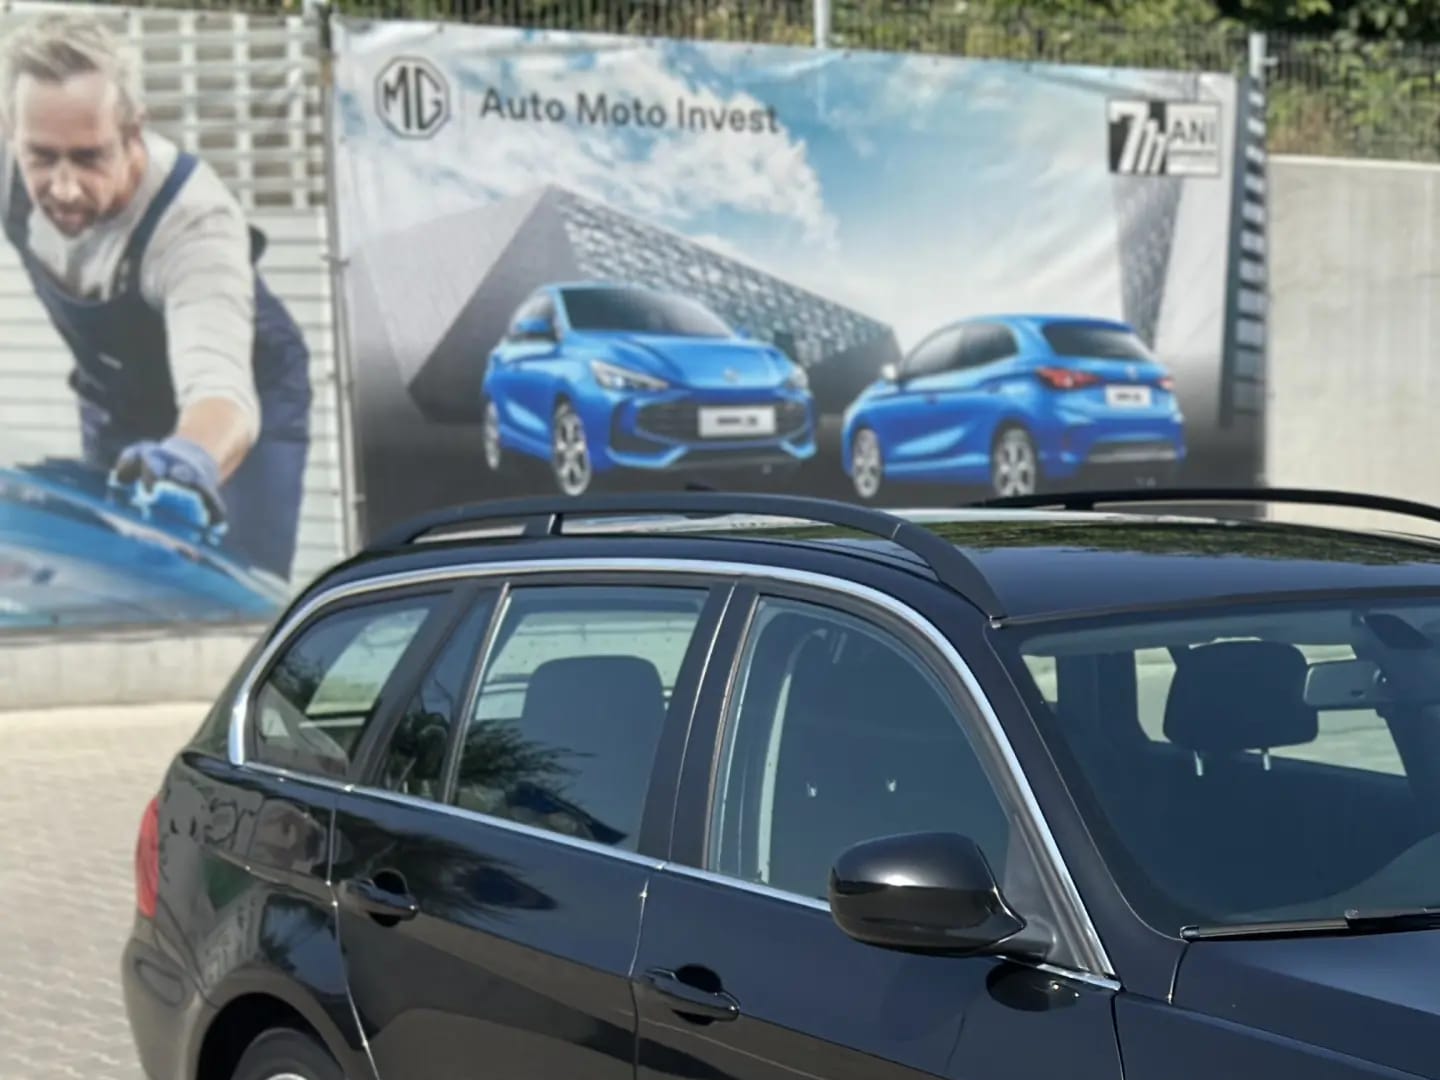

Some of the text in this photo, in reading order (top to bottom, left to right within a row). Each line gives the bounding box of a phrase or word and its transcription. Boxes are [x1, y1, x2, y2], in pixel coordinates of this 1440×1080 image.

[383, 66, 443, 131] MG
[480, 88, 781, 134] Auto Moto Invest
[1168, 118, 1216, 144] ANI
